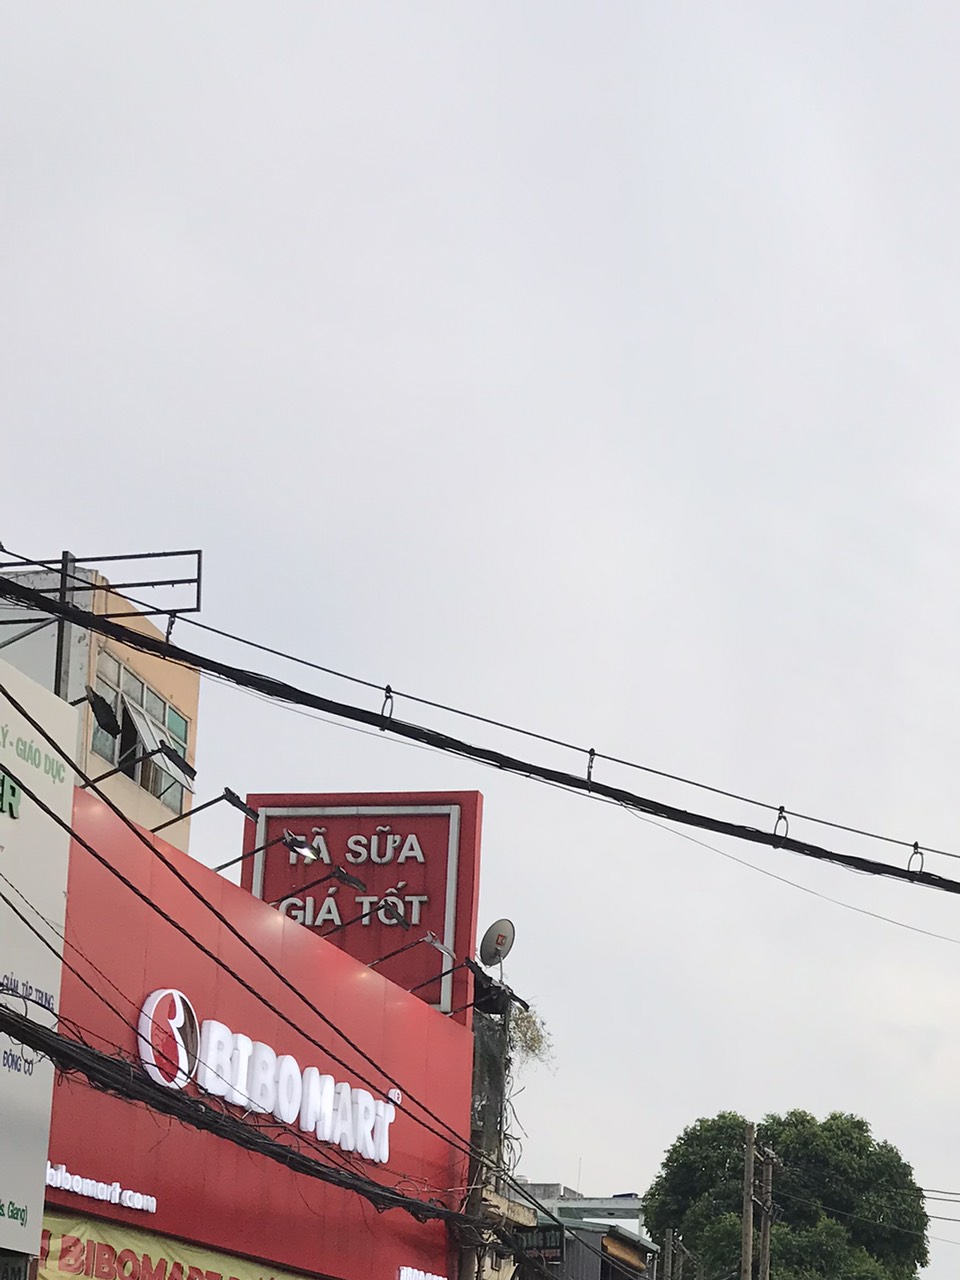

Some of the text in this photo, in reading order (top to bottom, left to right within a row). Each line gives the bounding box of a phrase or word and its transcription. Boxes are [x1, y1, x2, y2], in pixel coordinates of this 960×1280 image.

[15, 736, 42, 769] GIÁO
[44, 753, 67, 784] DỤC
[345, 826, 425, 864] SỮA
[278, 881, 428, 926] GIÁ TỐT
